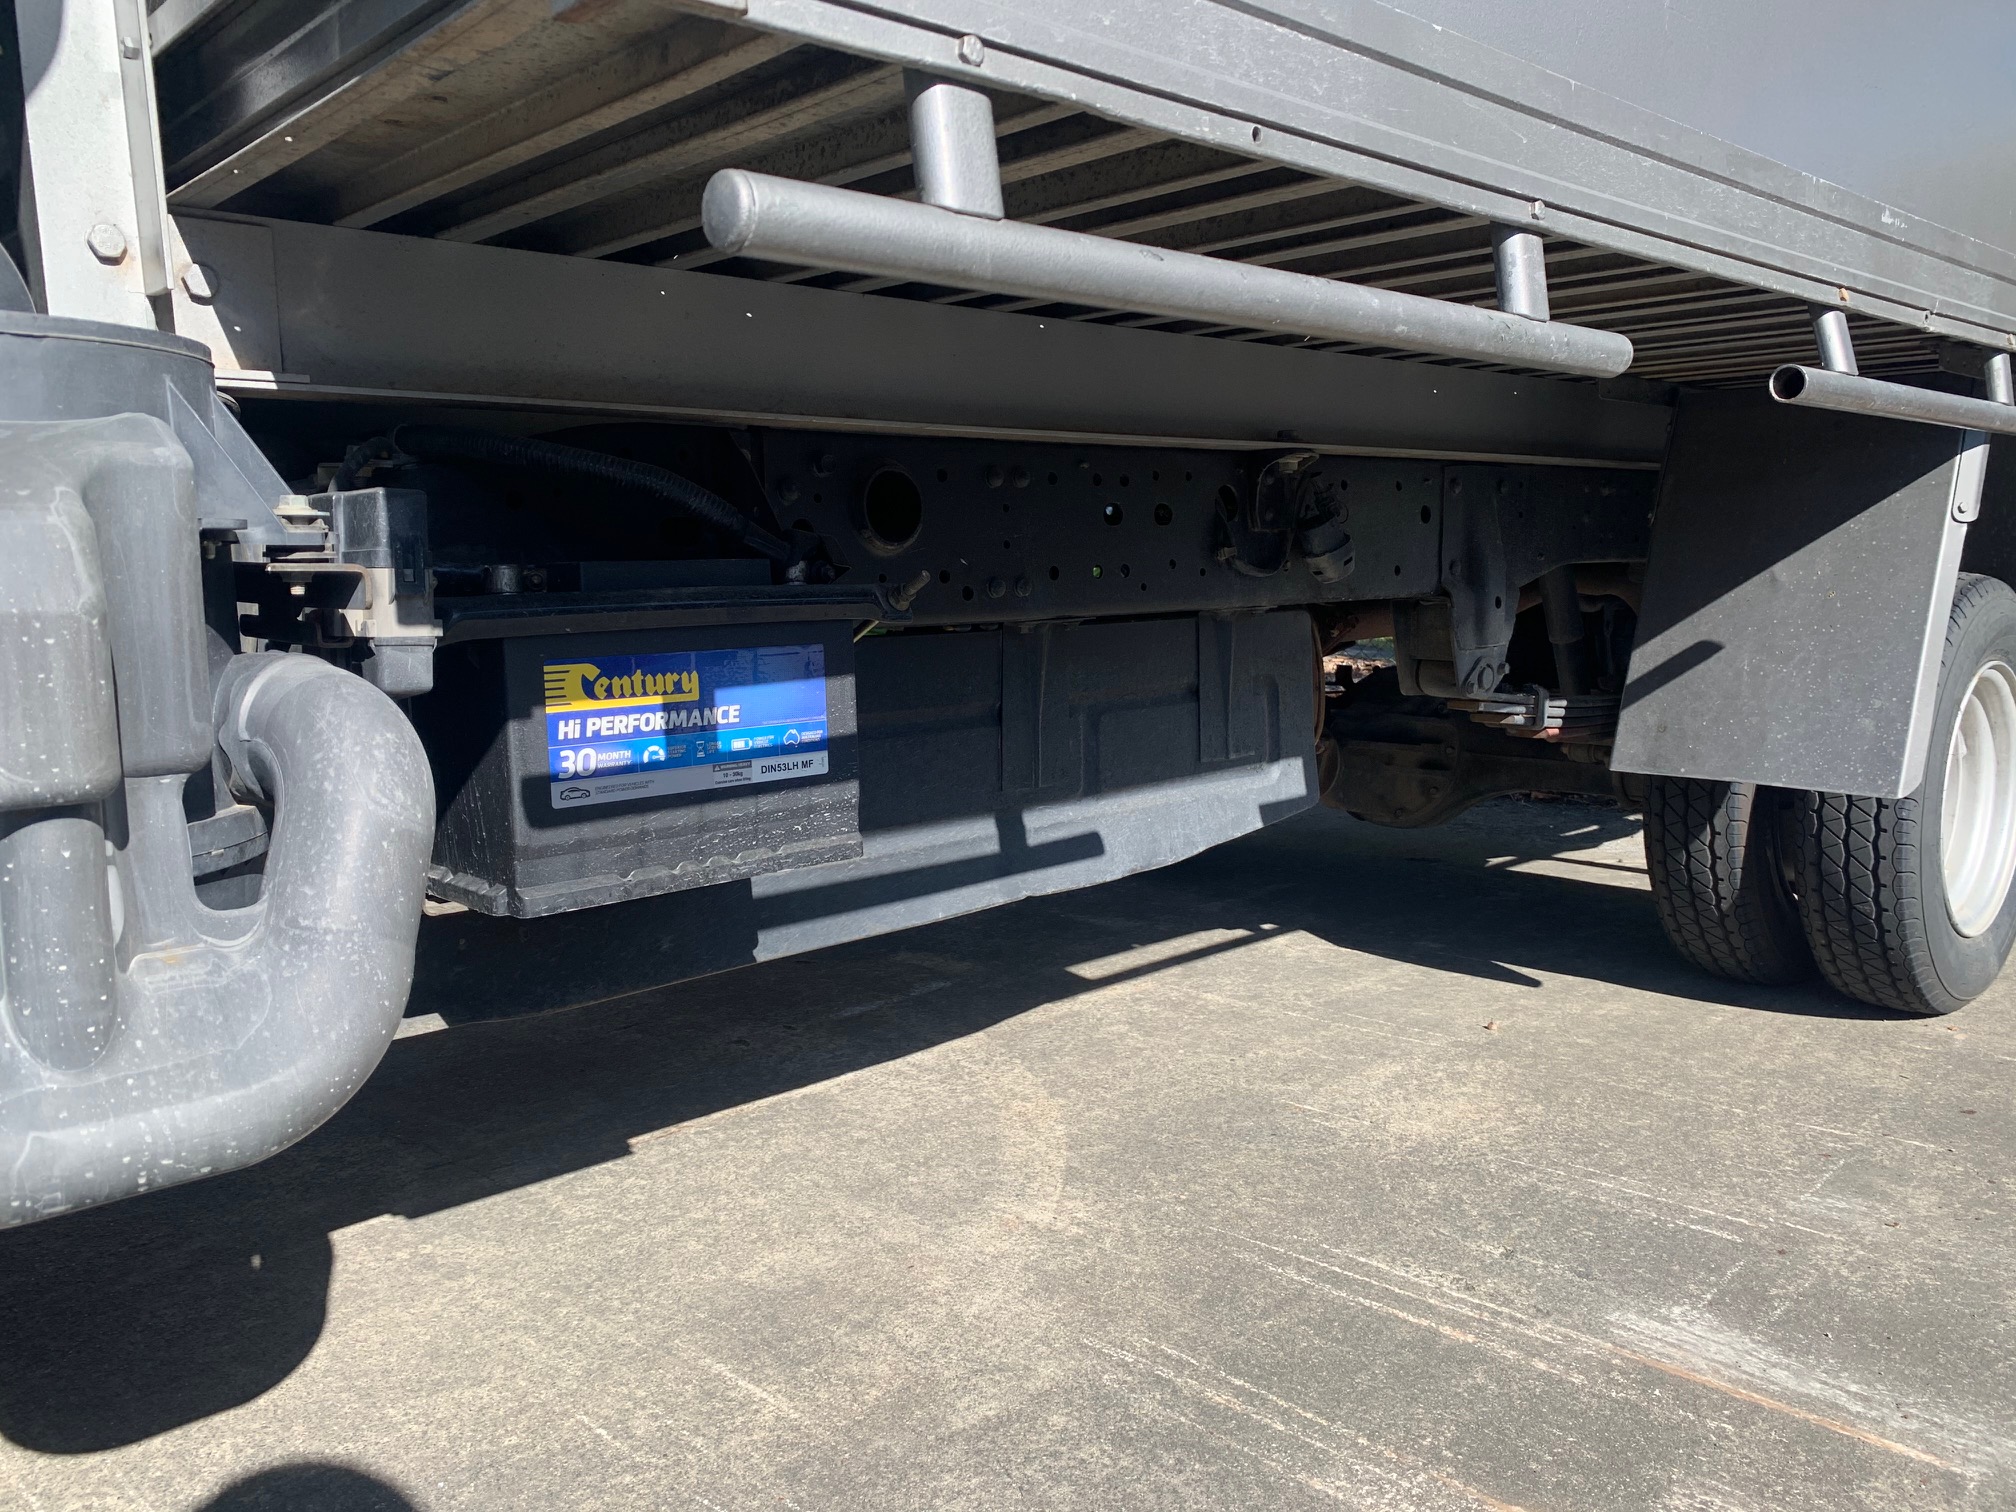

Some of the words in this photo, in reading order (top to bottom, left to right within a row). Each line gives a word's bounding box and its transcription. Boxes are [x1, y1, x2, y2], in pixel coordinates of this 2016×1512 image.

[544, 663, 699, 706] Century
[558, 717, 581, 740] Hi
[586, 705, 741, 737] PERFORMANCE
[558, 747, 597, 779] 30
[597, 750, 631, 761] MONTH
[597, 760, 632, 769] WARRANTY
[761, 761, 799, 774] DIN53LH
[801, 759, 814, 769] MF
